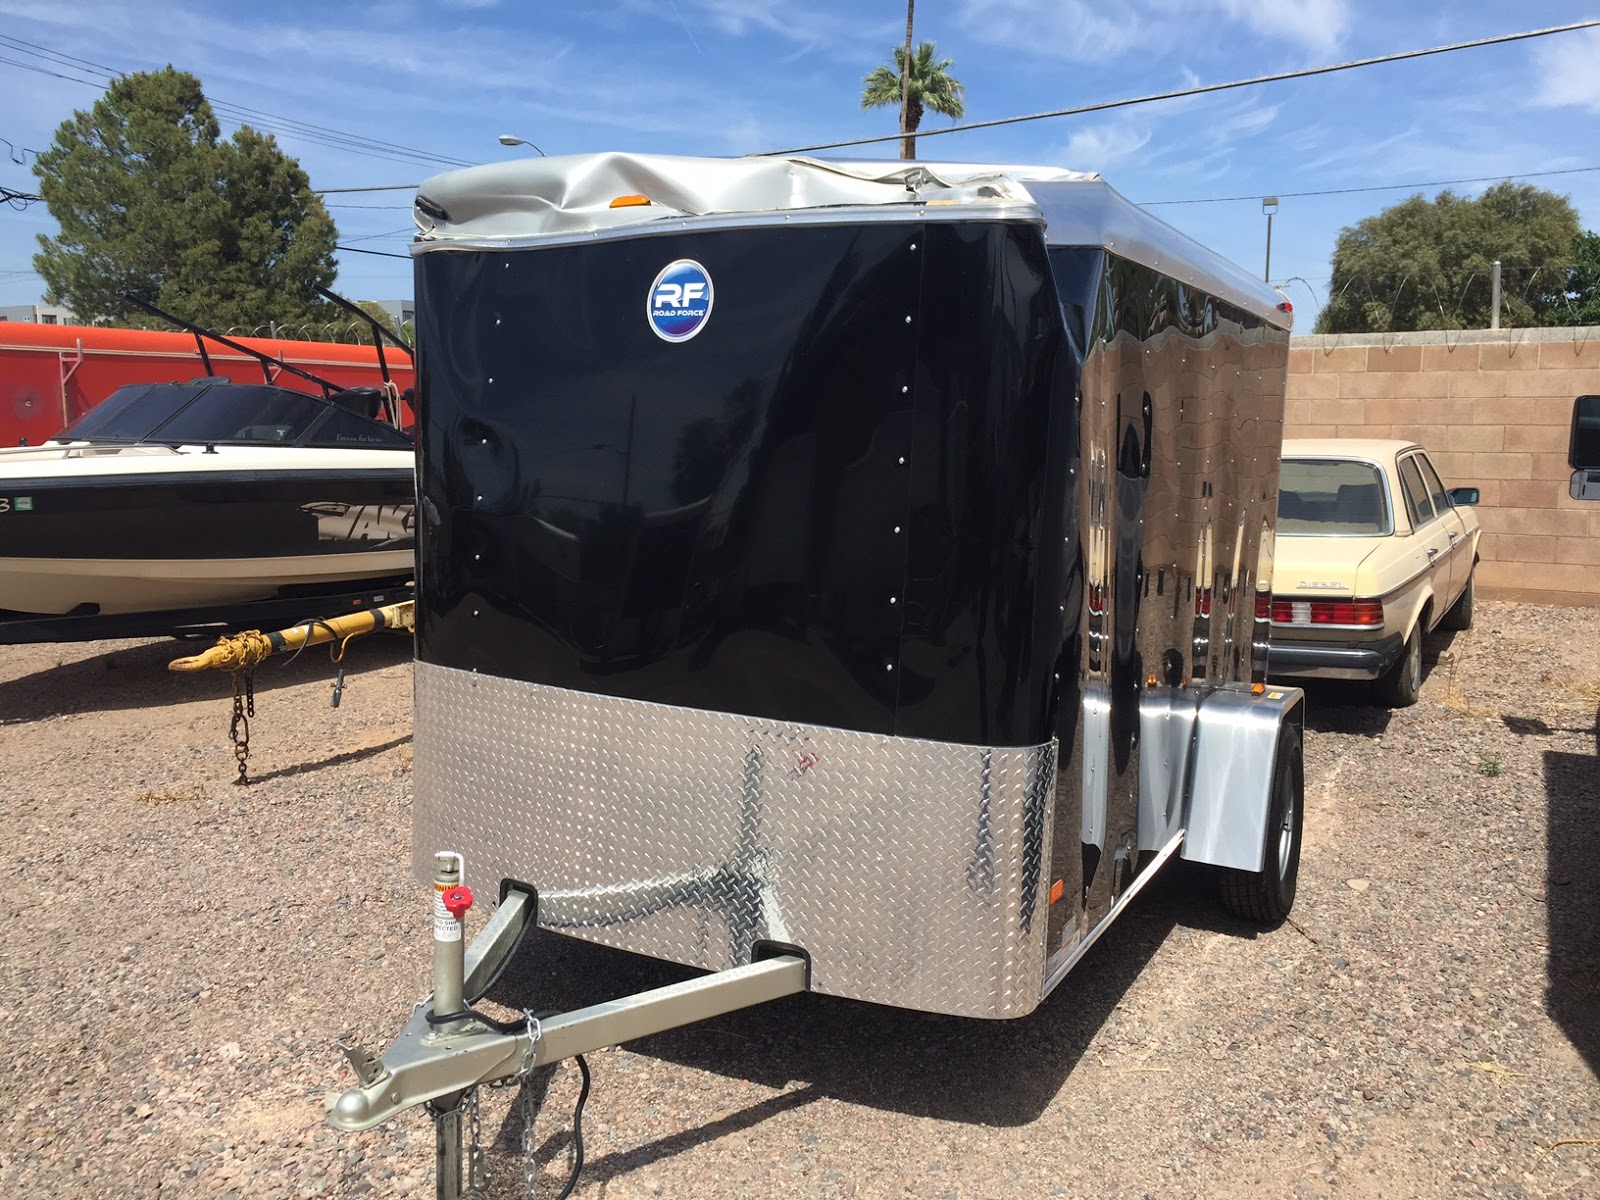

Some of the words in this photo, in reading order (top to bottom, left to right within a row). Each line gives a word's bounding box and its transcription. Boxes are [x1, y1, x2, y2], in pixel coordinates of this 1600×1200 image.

[655, 282, 706, 308] RF
[677, 309, 704, 317] FORCE
[1299, 580, 1346, 589] DIESEL
